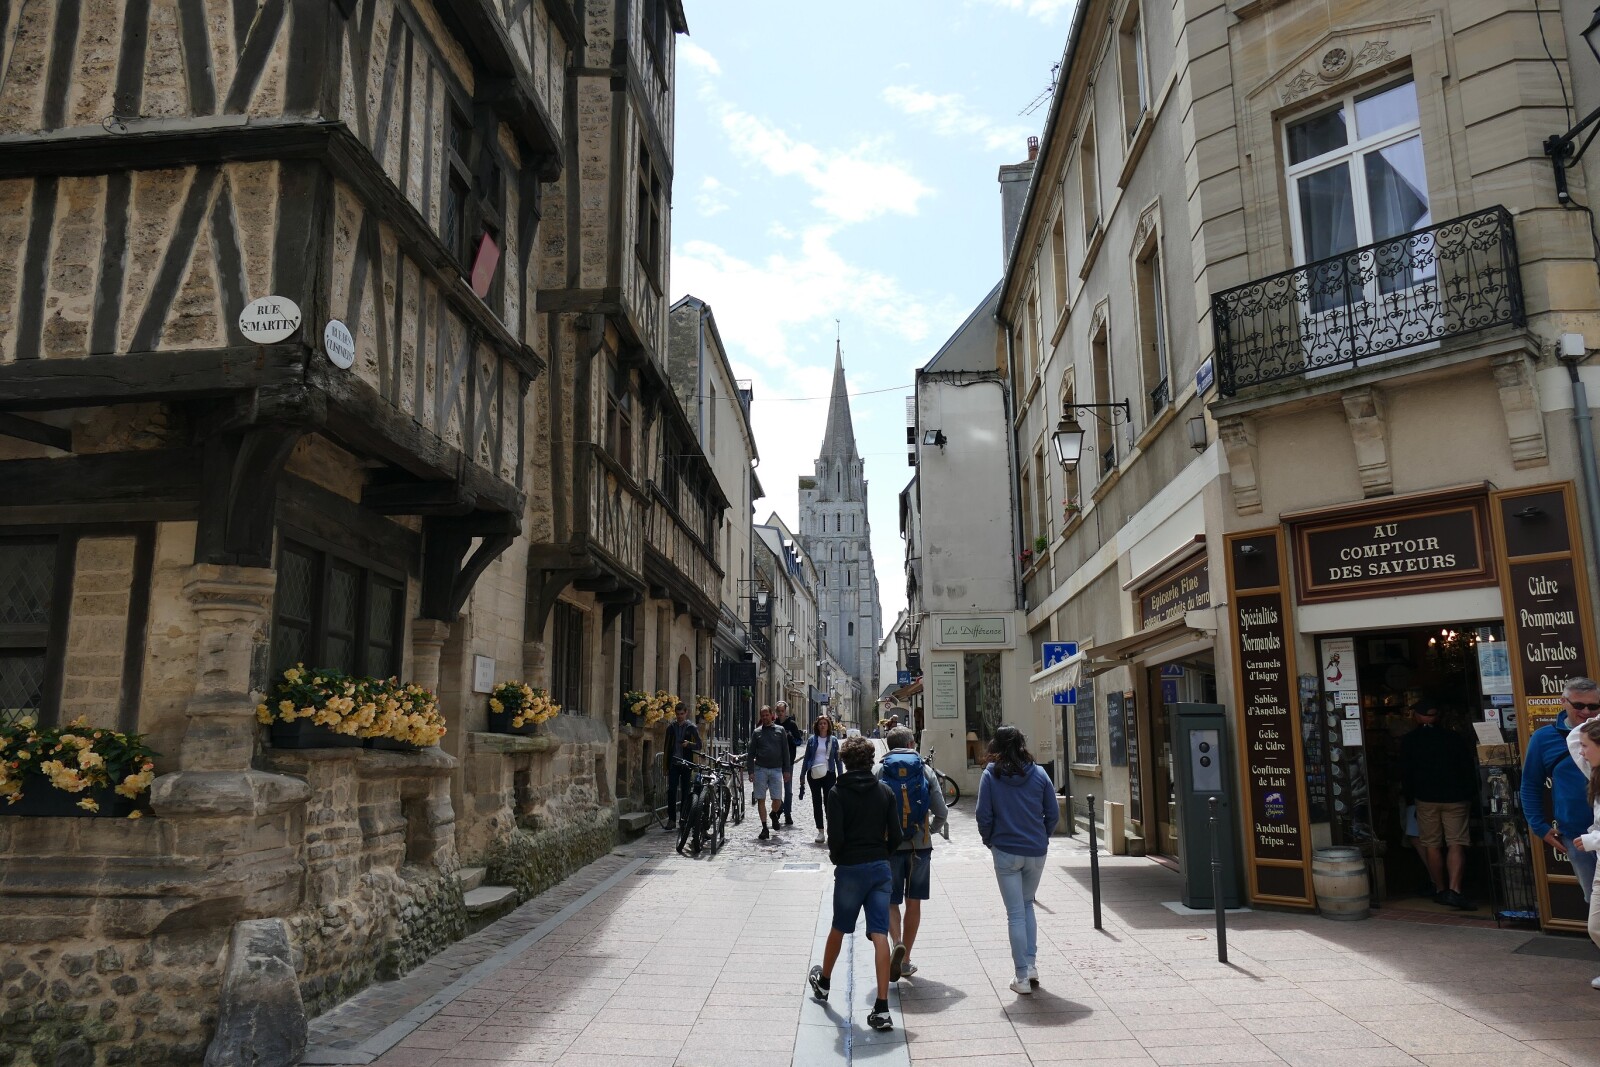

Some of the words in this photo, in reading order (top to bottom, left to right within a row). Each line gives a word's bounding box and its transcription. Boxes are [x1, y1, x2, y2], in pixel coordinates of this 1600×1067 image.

[257, 304, 280, 315] RUE
[1373, 523, 1398, 538] AU
[1340, 536, 1440, 561] COMPTOIR
[1329, 565, 1362, 580] DES
[1368, 554, 1456, 576] SAVEURS
[1181, 575, 1199, 594] Fine
[1528, 575, 1558, 596] Cidre
[1187, 596, 1194, 611] du
[1196, 591, 1210, 607] terro
[1240, 606, 1278, 630] Spécialités
[1520, 608, 1575, 630] Pommeau
[945, 626, 958, 635] La
[960, 624, 1002, 638] Différence
[1242, 632, 1280, 653] Normandes
[1526, 641, 1577, 662] Calvados
[1246, 659, 1280, 670] Caramels
[1249, 672, 1278, 681] d'Isigny
[1254, 694, 1278, 704] Sablés
[1248, 706, 1286, 716] d'Asnelles
[1258, 729, 1279, 739] Gelée
[1254, 742, 1262, 750] de
[1266, 742, 1285, 750] Cidre
[1252, 765, 1290, 775] Confitures
[1259, 778, 1267, 786] de
[1270, 777, 1285, 786] Lait
[1256, 823, 1297, 834] Andouilles
[1260, 835, 1284, 847] Tripes
